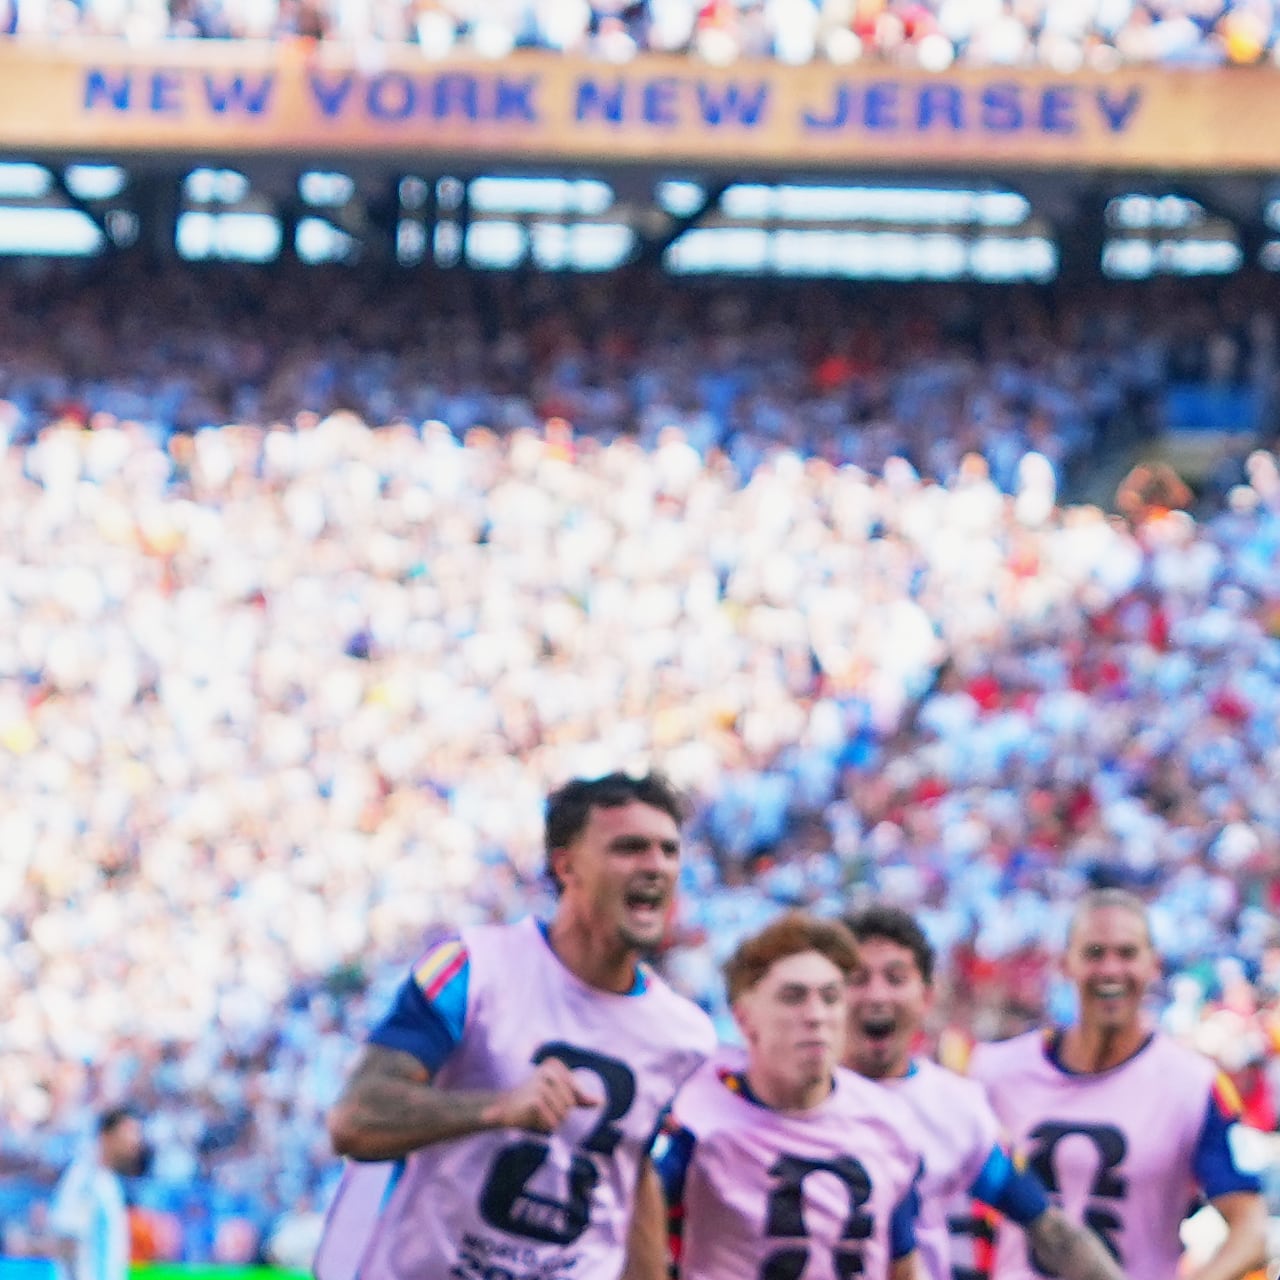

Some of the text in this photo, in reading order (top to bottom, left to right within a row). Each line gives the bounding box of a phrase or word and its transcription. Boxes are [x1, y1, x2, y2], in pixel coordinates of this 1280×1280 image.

[82, 68, 1147, 134] NEW YORK NEW JERSEY
